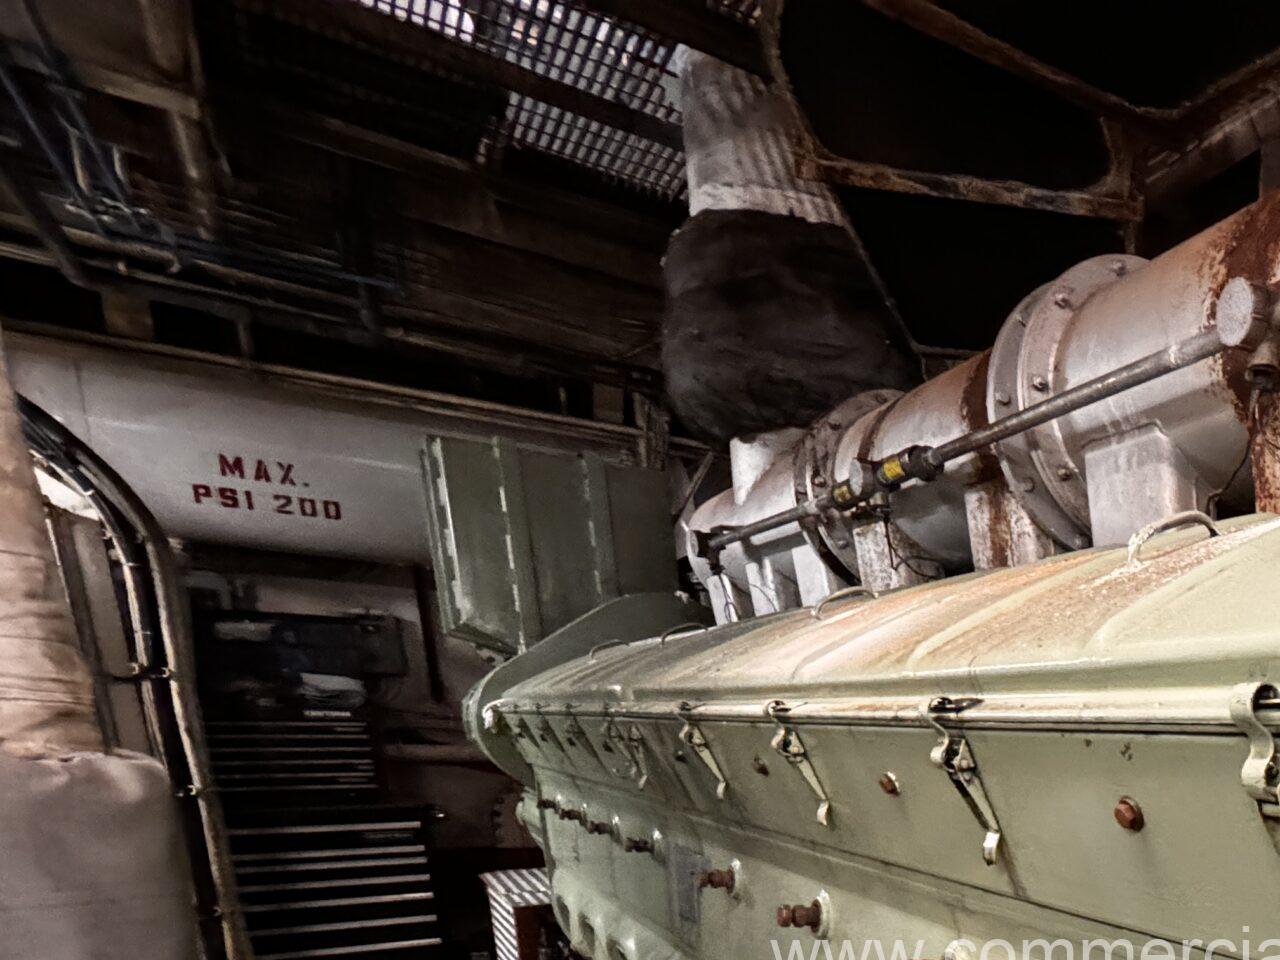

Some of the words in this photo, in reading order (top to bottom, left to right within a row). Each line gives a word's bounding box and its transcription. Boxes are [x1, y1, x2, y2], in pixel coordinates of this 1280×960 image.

[218, 453, 310, 487] MAX.
[192, 483, 254, 510] PSI
[273, 494, 341, 520] 200
